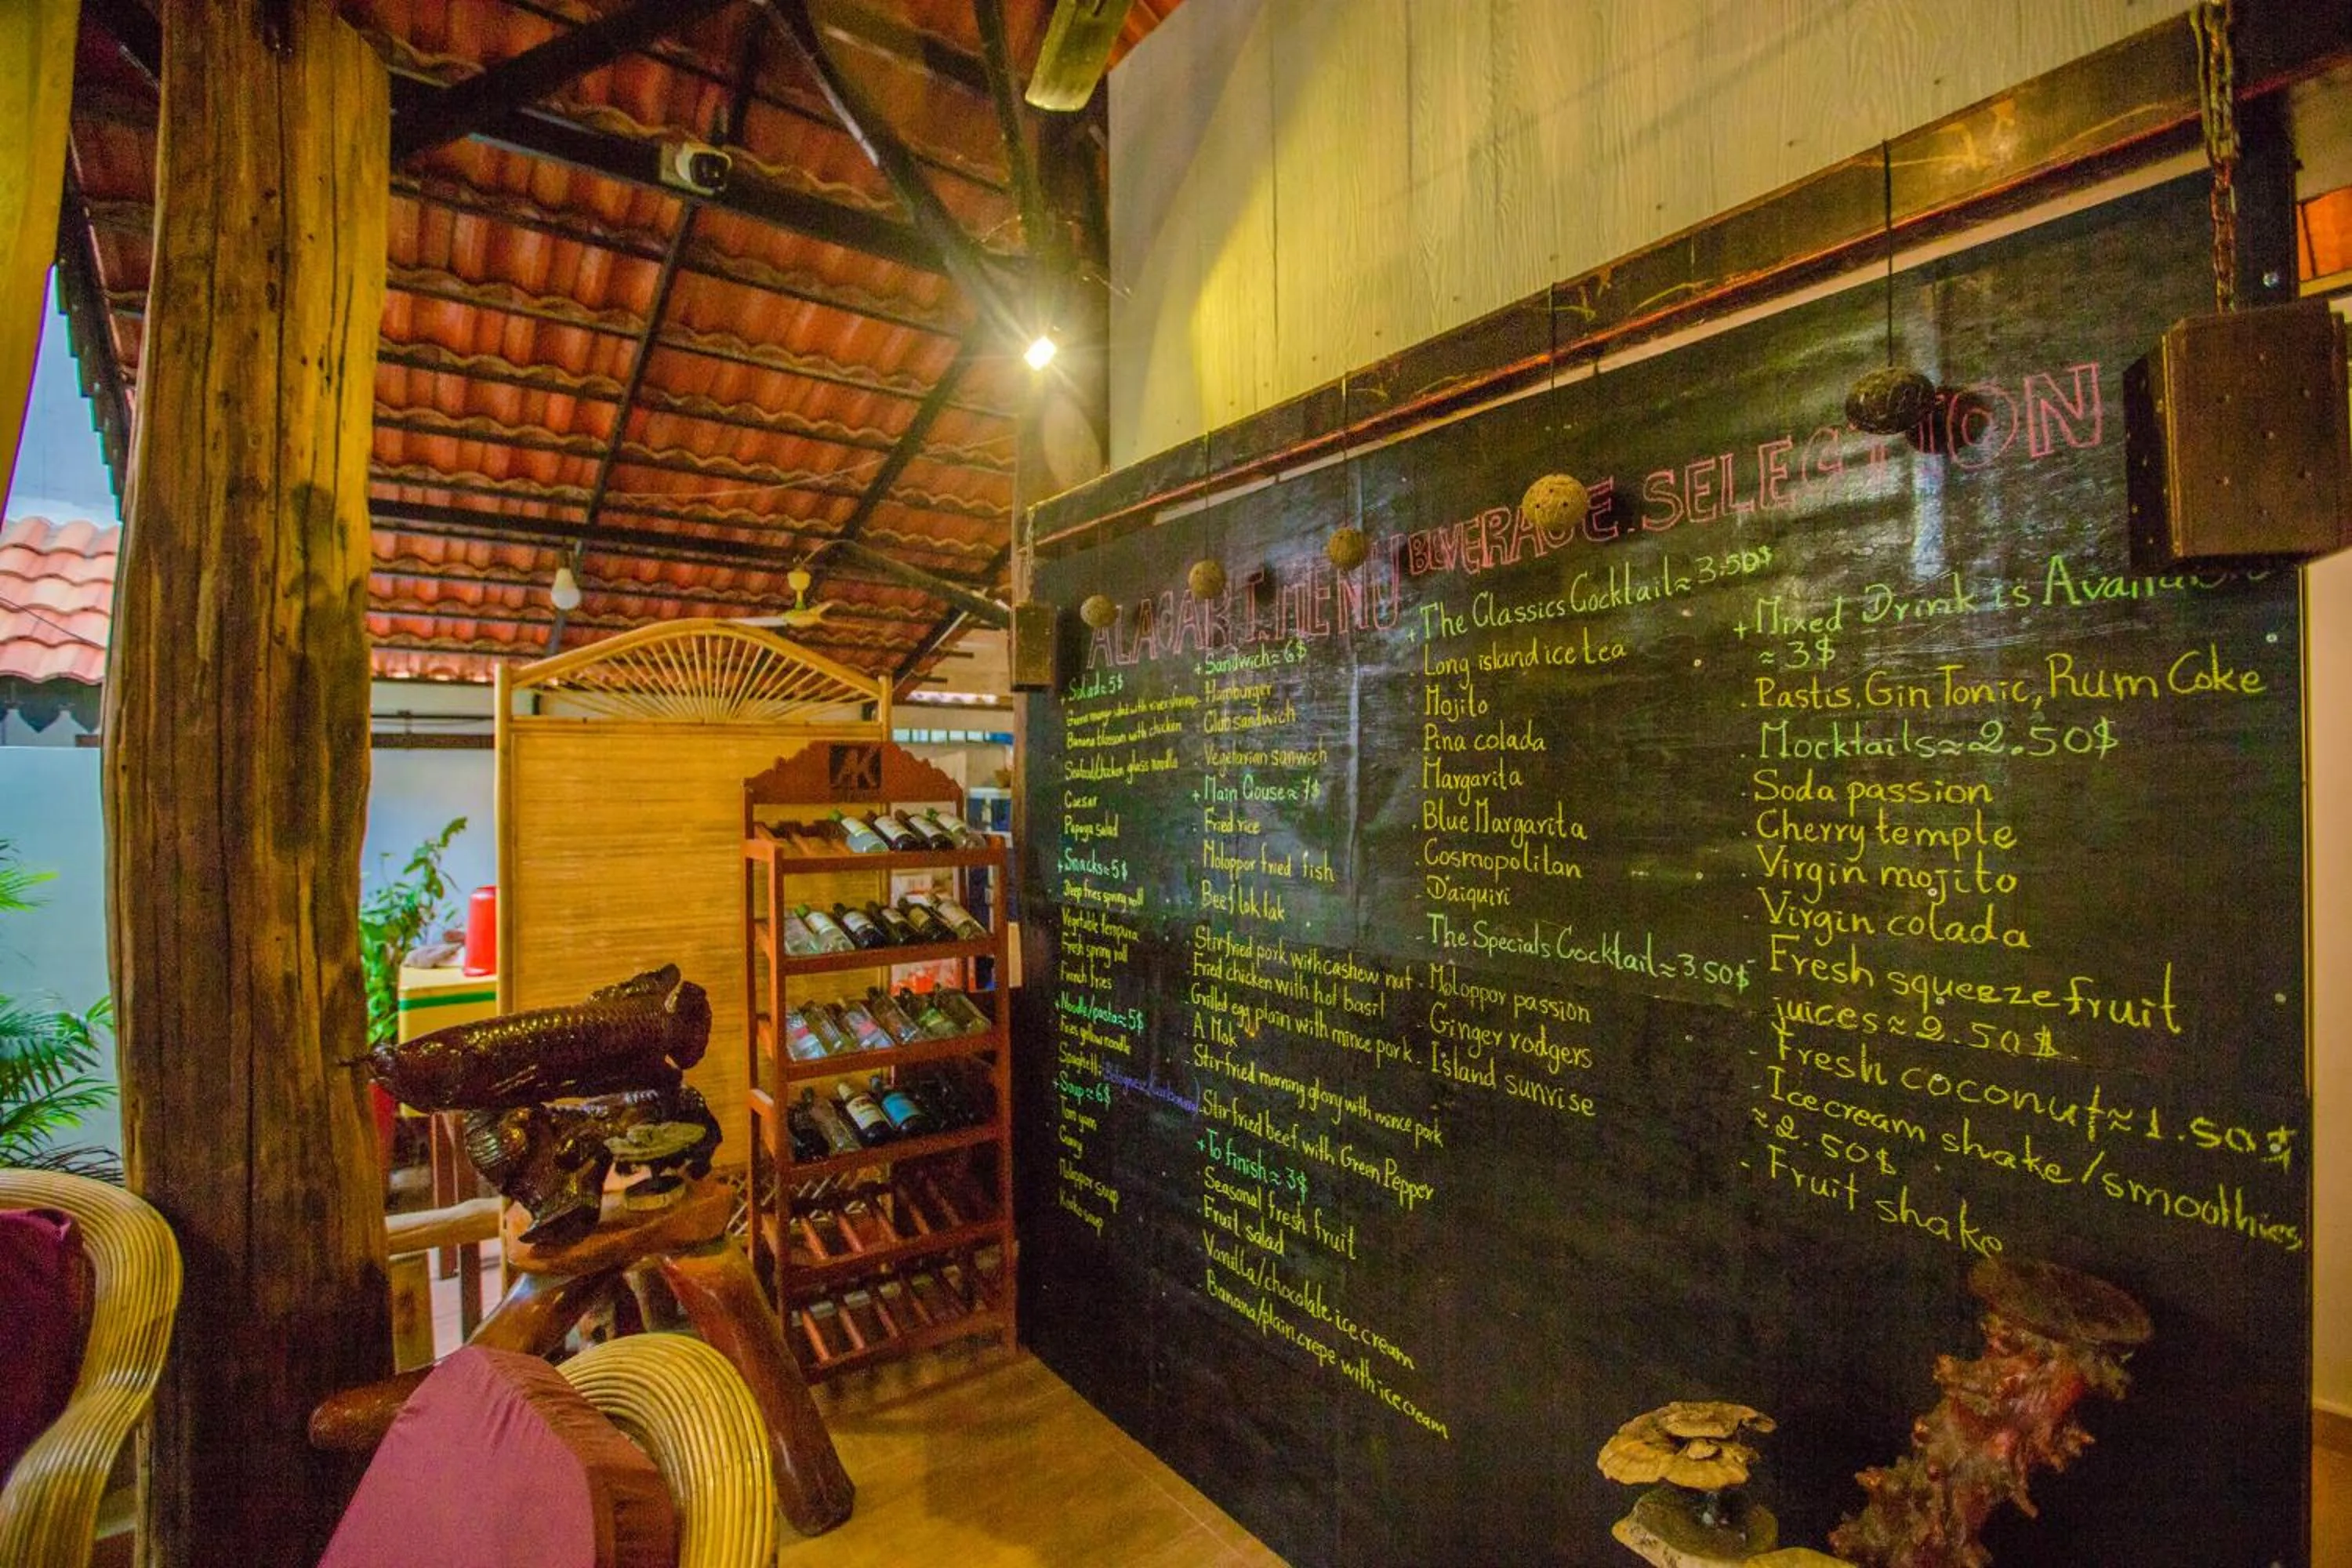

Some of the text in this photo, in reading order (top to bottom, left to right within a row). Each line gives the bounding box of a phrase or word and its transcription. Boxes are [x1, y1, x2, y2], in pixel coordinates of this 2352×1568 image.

[1408, 475, 1618, 575] BEVERAE
[1421, 603, 1467, 641] The
[1473, 591, 1565, 627] Classics
[1757, 596, 1843, 634] Mixed
[1424, 627, 1625, 689] Long island ice tea
[1866, 671, 1930, 709] Gin
[2045, 652, 2158, 700] Rum
[2169, 643, 2267, 694] Coke
[1204, 680, 1272, 706] Hamburger
[1232, 699, 1295, 729] sandwich
[1425, 684, 1488, 722] Mojito
[1424, 720, 1545, 752] Pina colada
[1204, 775, 1237, 802] Main
[1423, 757, 1523, 807] Margarita
[1755, 769, 1992, 817] Soda passion
[1205, 808, 1261, 835] Fried rice
[1423, 799, 1588, 848] Blue Margarita
[1757, 808, 2017, 861] Cherry temple
[1261, 842, 1291, 878] fried
[1302, 850, 1334, 882] fish
[1425, 838, 1582, 883] Cosmopolitan
[1757, 844, 2017, 905] Virgin mojito
[1201, 880, 1236, 915] Beef
[1758, 887, 2031, 947] Virgin colada
[1257, 938, 1287, 967] pork
[1426, 913, 1468, 946] The
[1474, 920, 1551, 960] Specials
[1193, 953, 1221, 979] Fried
[1226, 960, 1272, 991] chicken
[1276, 975, 1308, 1000] with
[1315, 979, 1336, 1007] hot
[1771, 935, 1873, 986] Fresh
[2064, 962, 2181, 1033] fruit
[1514, 993, 1591, 1023] passion
[1377, 1036, 1412, 1069] pork
[1430, 1001, 1593, 1074] Ginger rodgers
[1773, 1033, 1888, 1085] Fresh
[1432, 1040, 1595, 1116] Island sunrise
[1415, 1118, 1443, 1149] pork
[1768, 1144, 2003, 1257] Fruit shake
[1203, 1195, 1284, 1256] Fruit salad
[1313, 1208, 1356, 1261] fruit
